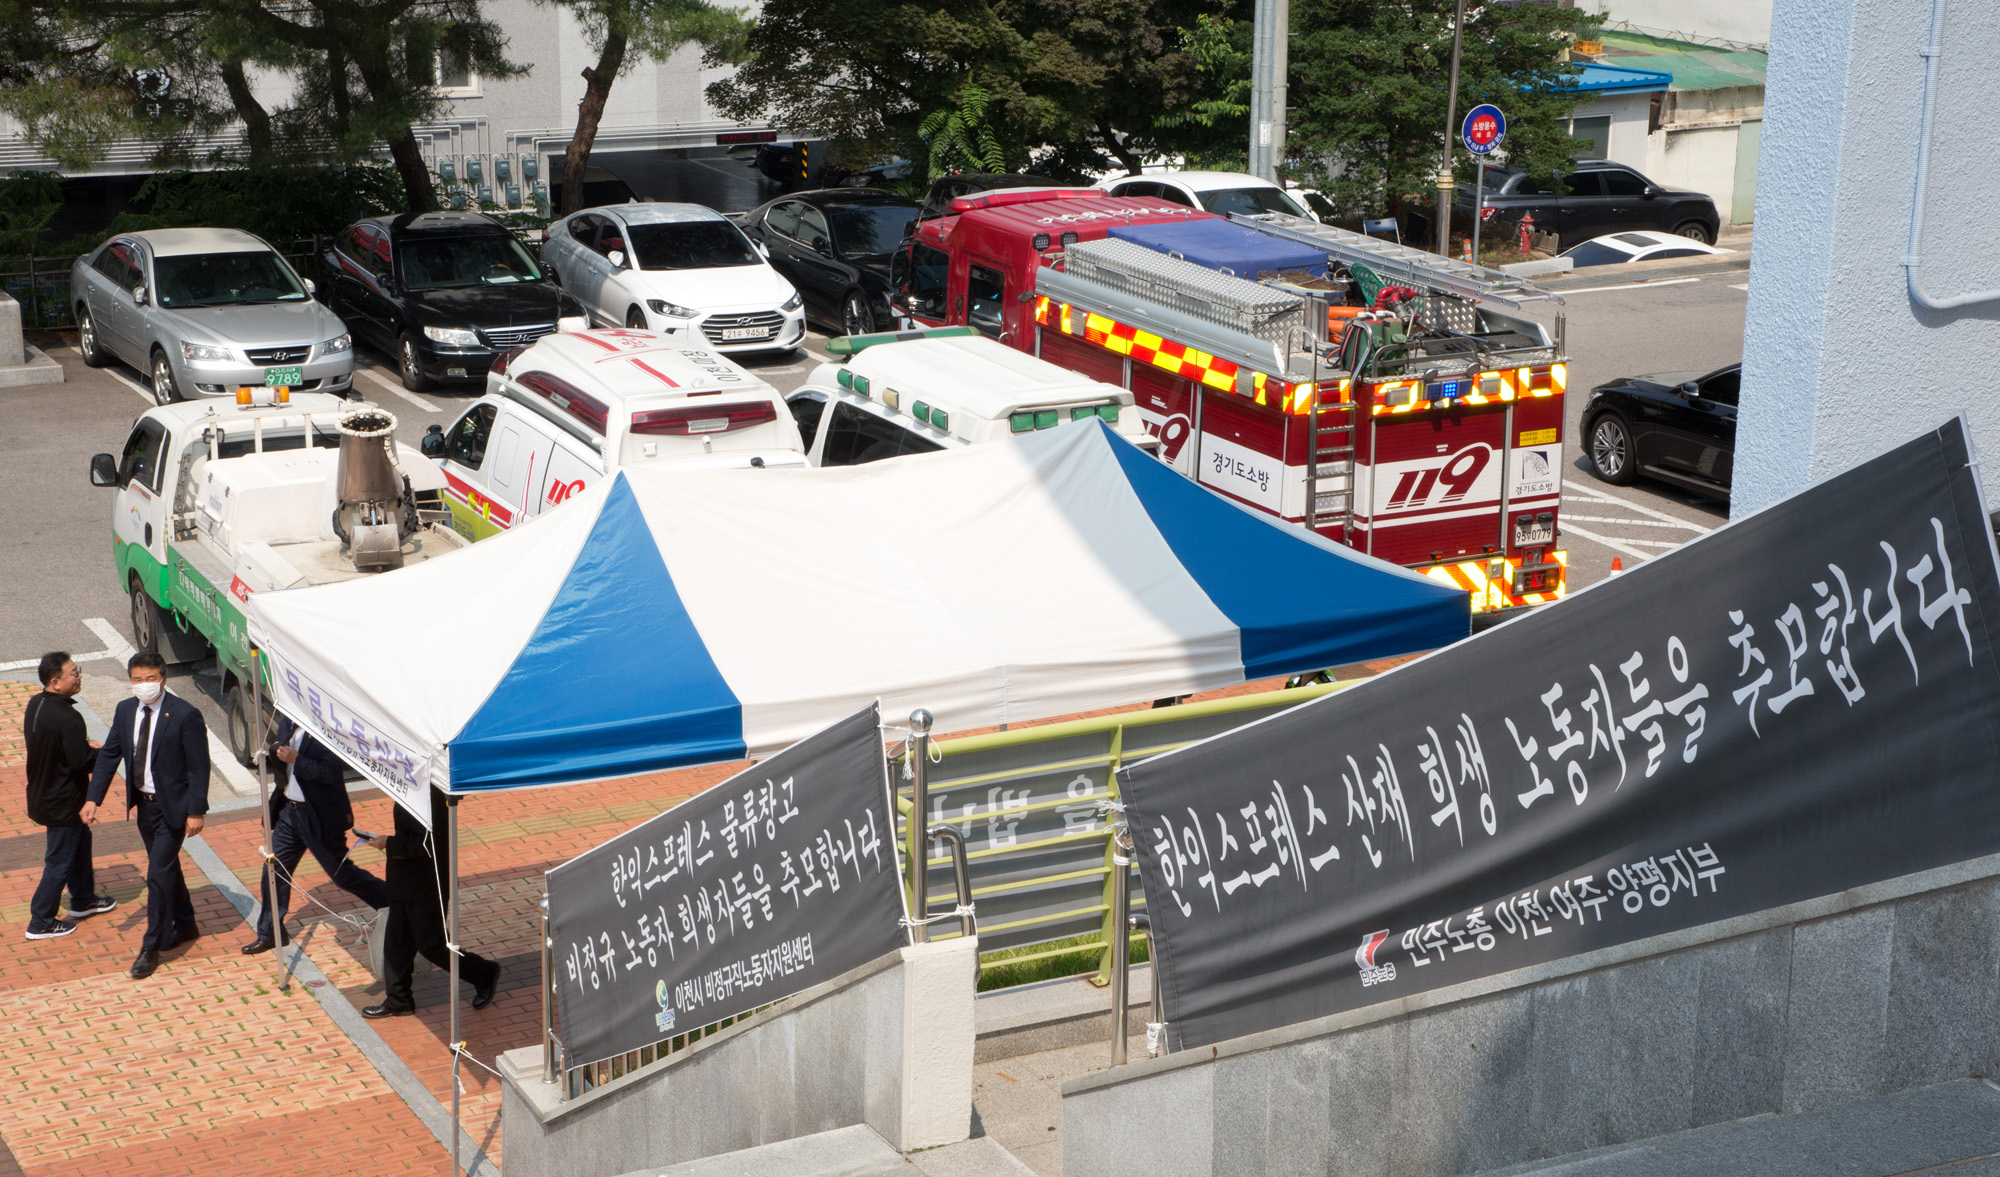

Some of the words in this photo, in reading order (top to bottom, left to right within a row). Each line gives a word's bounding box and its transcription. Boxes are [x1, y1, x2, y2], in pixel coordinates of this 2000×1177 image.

[1472, 121, 1496, 131] 소방용수
[745, 328, 766, 337] 9456
[267, 372, 300, 385] 9789
[1213, 452, 1270, 492] 경기도소방
[1385, 446, 1491, 510] 119
[1515, 482, 1553, 495] 경기도소방
[1153, 779, 1340, 918] 한익스프레스
[1341, 743, 1414, 868] 산재
[1417, 712, 1497, 847] 희생
[1504, 635, 1709, 808] 노동자들을
[1728, 517, 1974, 739] 추모합니다
[611, 819, 715, 908] 한익스프레스
[720, 776, 799, 859] 물류창고
[566, 930, 617, 995] 비정규
[621, 904, 675, 968] 노동자
[677, 863, 774, 952] 희생자들을
[779, 808, 881, 909] 추모합니다
[1401, 906, 1496, 967] 민주노총
[675, 976, 704, 1013] 이천시
[704, 933, 814, 1002] 비정규직노동자지원센터
[1359, 962, 1397, 987] 민주노총
